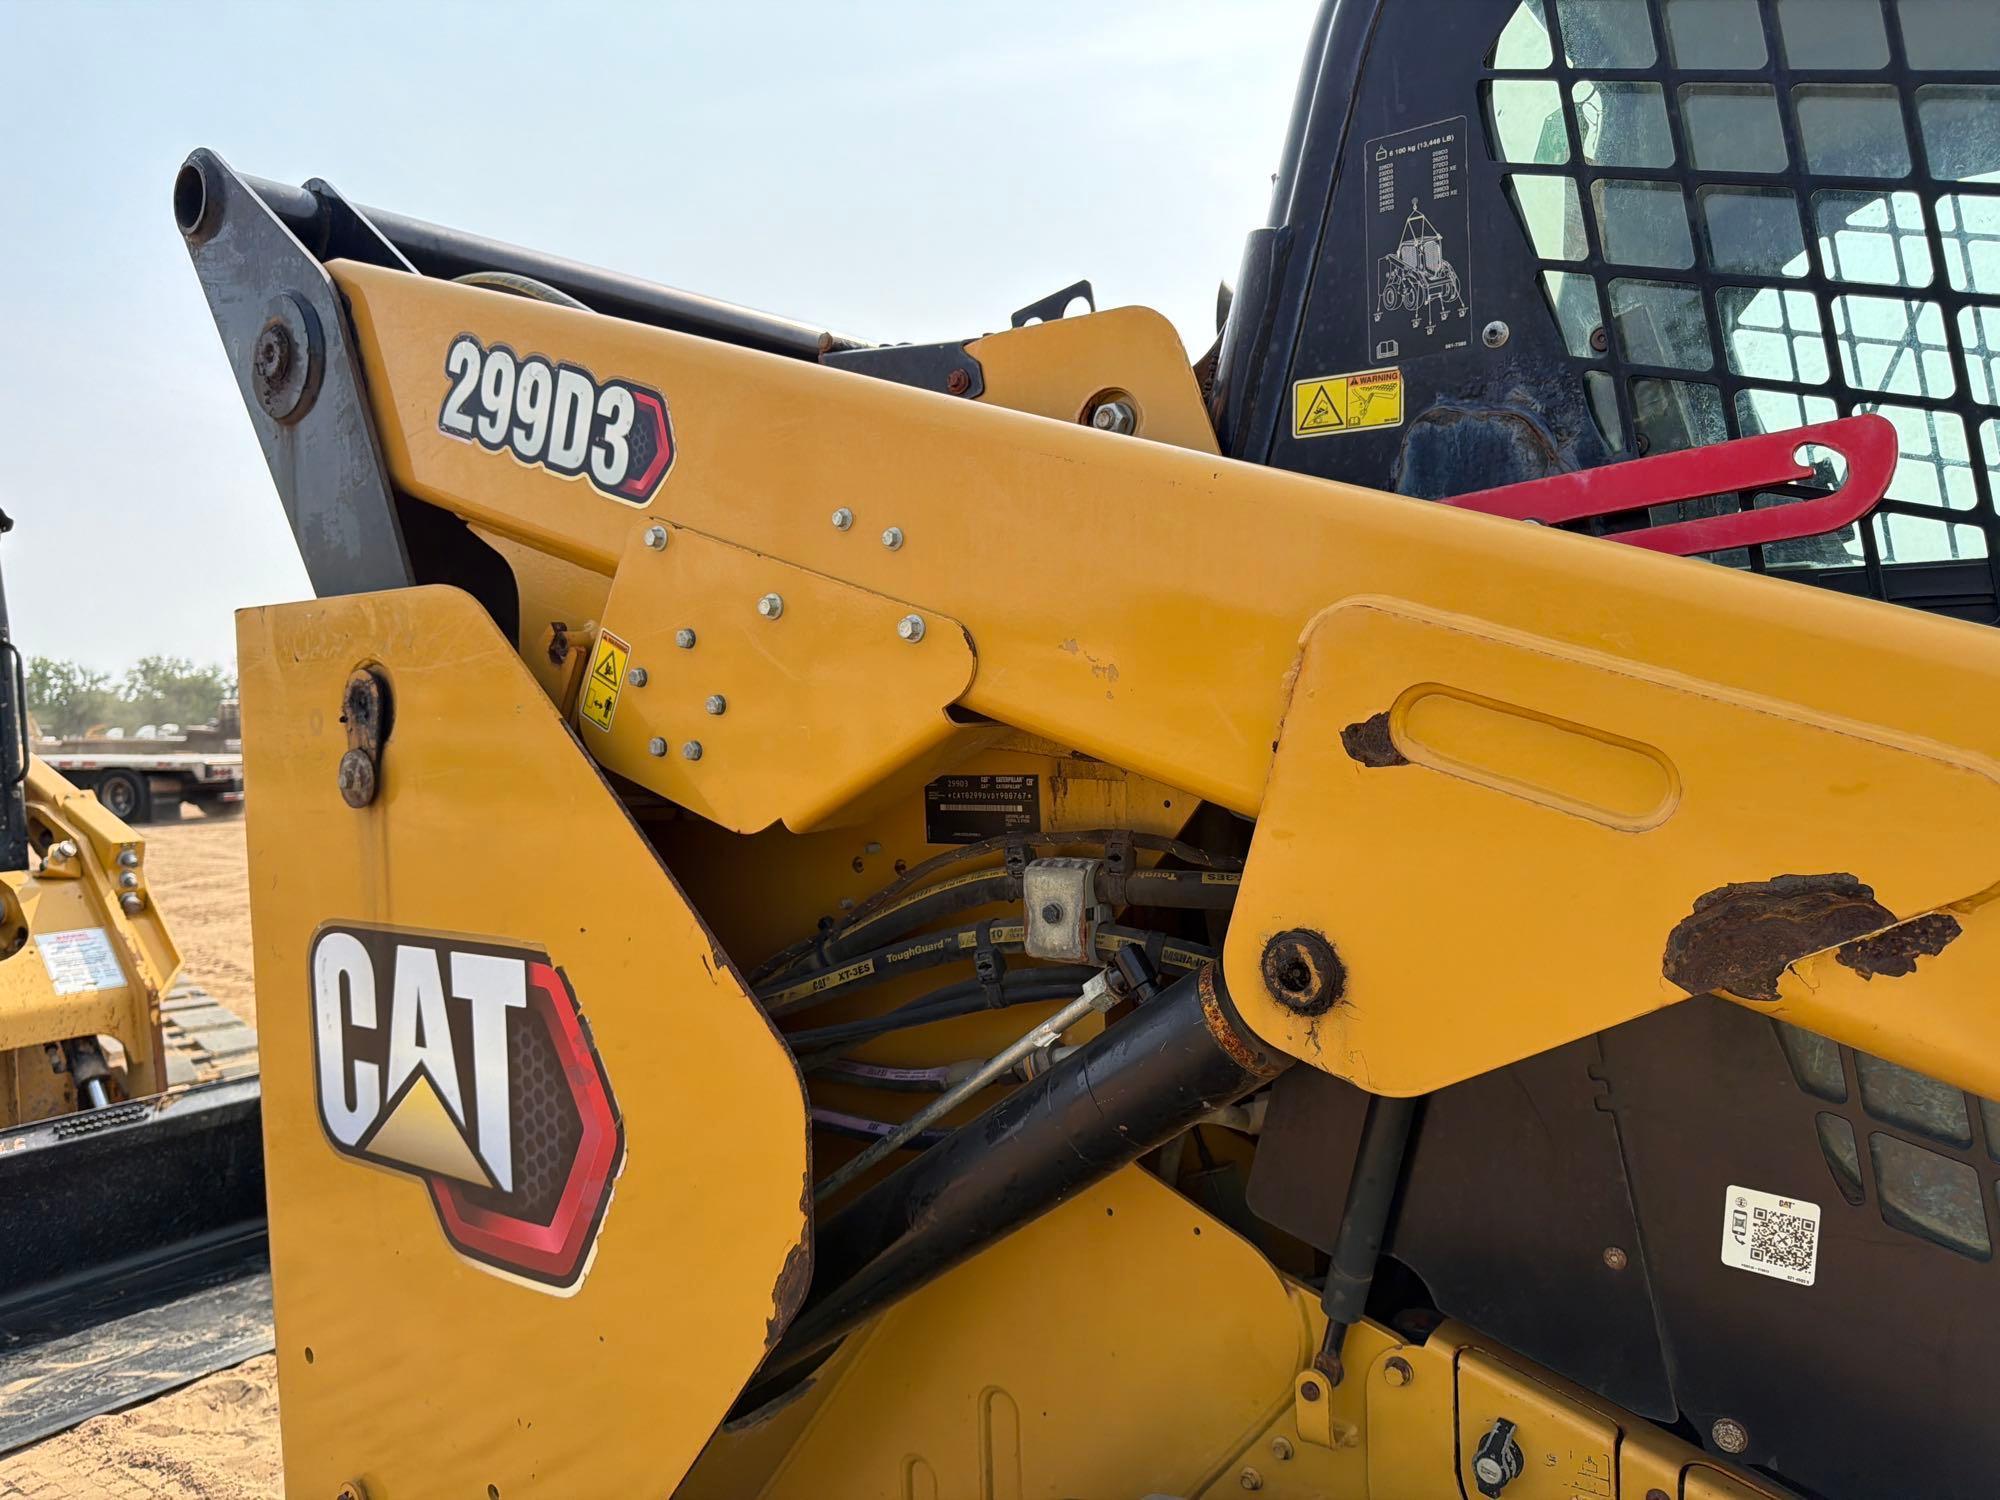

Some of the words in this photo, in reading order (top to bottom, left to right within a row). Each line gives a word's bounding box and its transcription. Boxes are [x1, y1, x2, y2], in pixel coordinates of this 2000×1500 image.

[1395, 147, 1406, 155] 100
[1442, 134, 1455, 143] LB)
[1360, 372, 1398, 384] WARNING
[442, 340, 635, 486] 299D3
[838, 963, 870, 982] XT-3ES
[314, 932, 527, 1193] CAT
[1778, 1200, 1792, 1210] CAT
